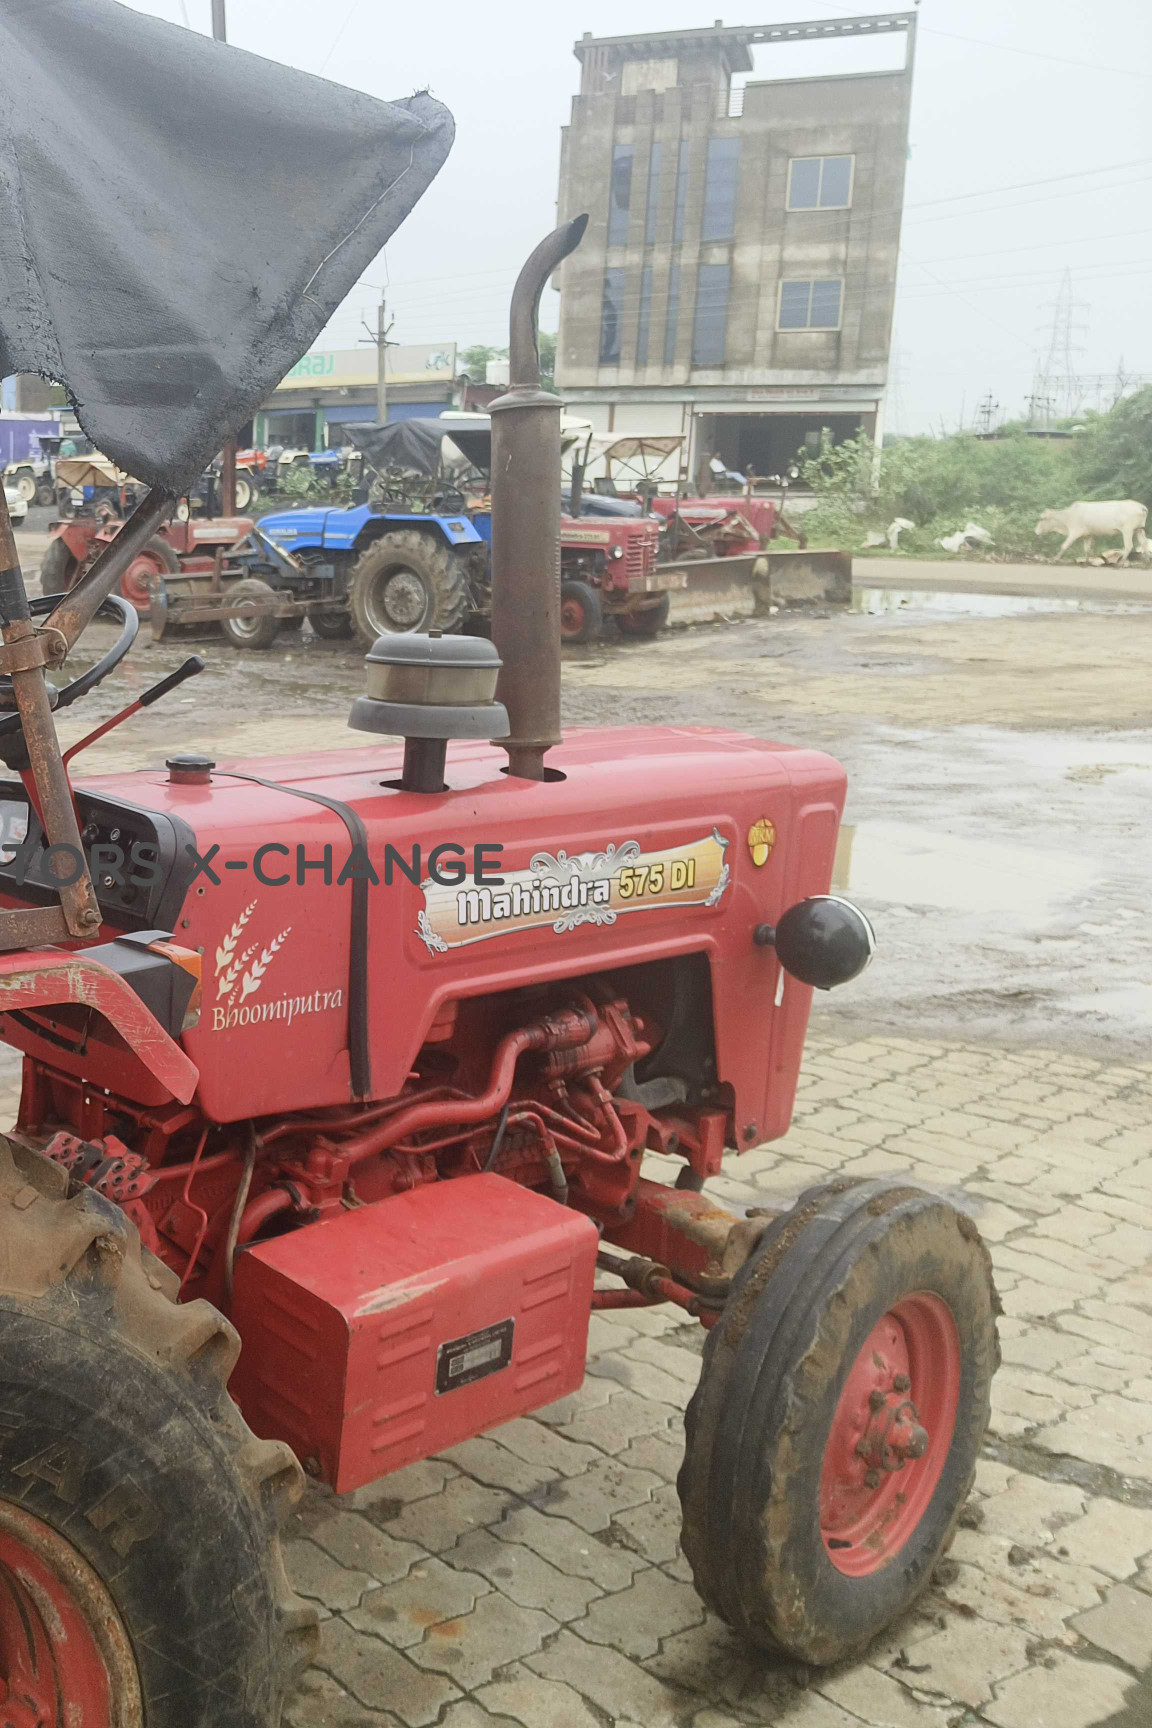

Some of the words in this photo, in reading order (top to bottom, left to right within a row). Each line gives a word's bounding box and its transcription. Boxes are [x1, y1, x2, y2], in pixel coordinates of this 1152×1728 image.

[456, 876, 611, 926] Mahindra
[619, 864, 665, 899] 575
[670, 858, 696, 890] DI
[211, 988, 344, 1031] Bhoomiputra
